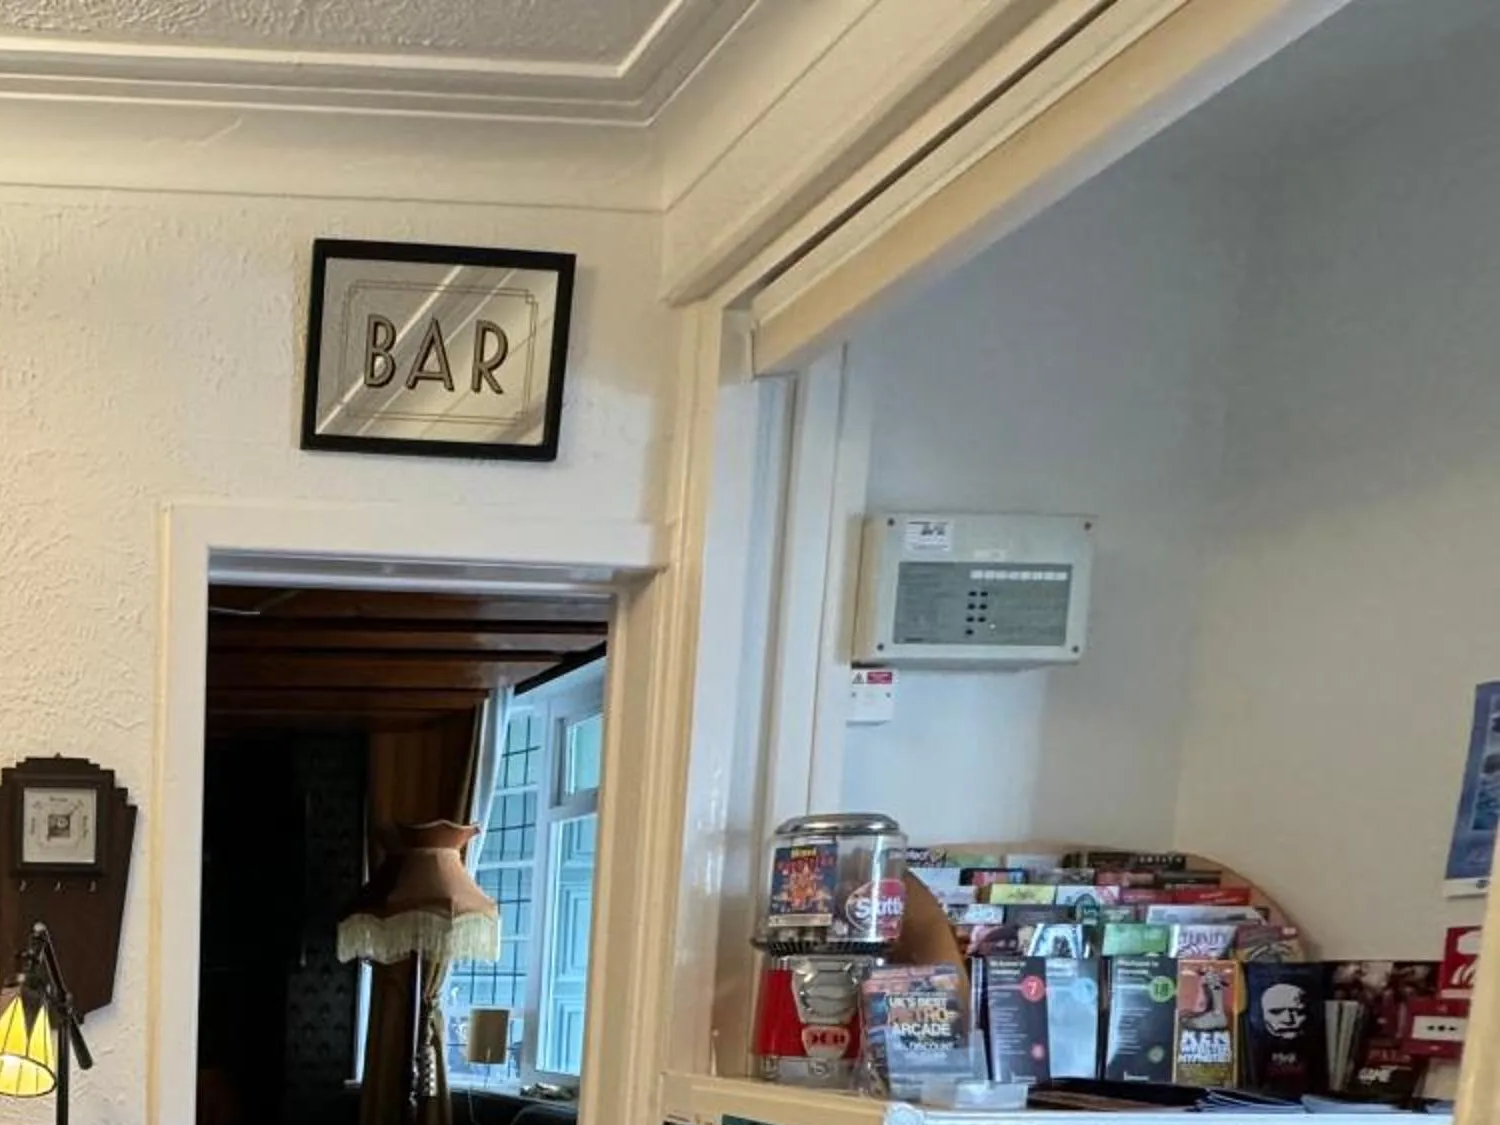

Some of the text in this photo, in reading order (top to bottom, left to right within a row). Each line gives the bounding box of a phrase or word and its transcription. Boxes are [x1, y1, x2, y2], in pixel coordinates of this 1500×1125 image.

[363, 313, 509, 395] BAR
[1027, 982, 1038, 995] 7
[891, 1022, 951, 1037] ARCADE
